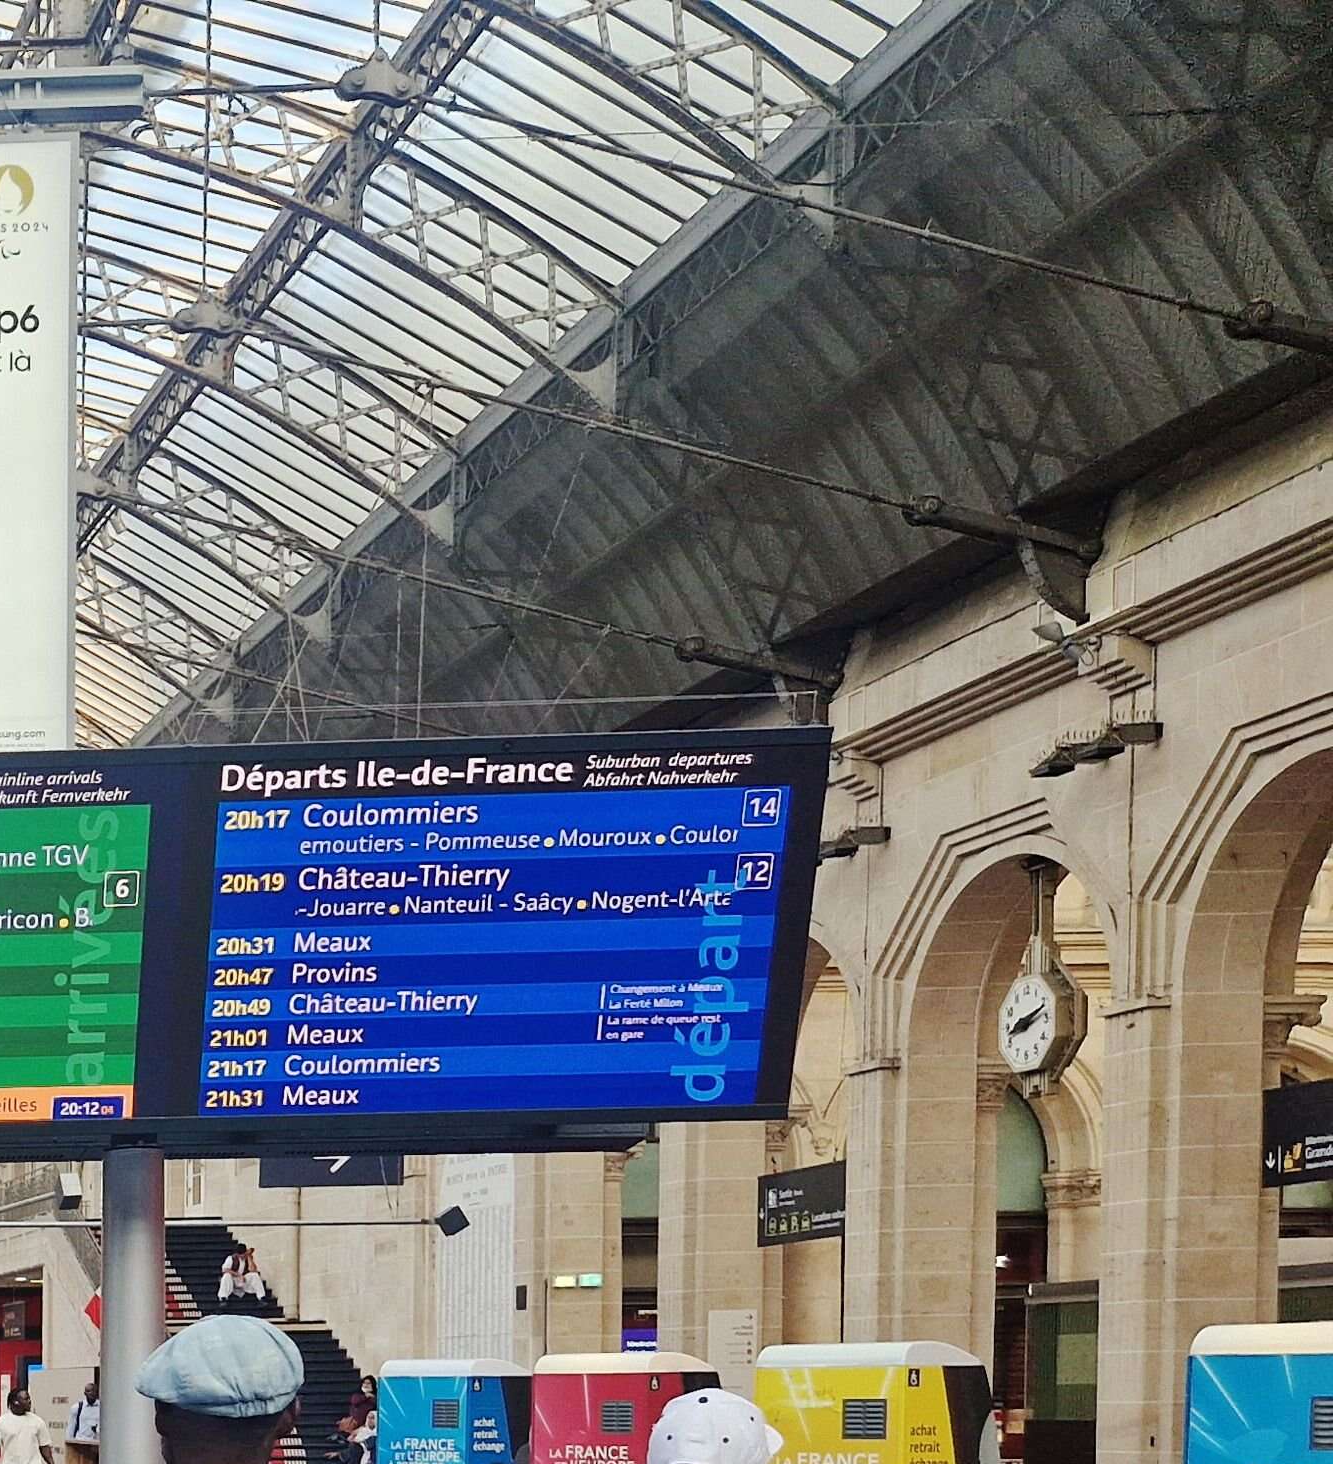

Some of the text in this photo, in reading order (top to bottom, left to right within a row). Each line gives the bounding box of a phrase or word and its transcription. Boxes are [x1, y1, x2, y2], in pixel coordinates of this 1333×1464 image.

[12, 222, 50, 233] 2024
[9, 348, 32, 373] là
[586, 752, 753, 769] Suburban departures
[47, 770, 103, 785] arrivals
[220, 757, 573, 797] Départs Ile-de-France
[583, 770, 739, 788] Abfahrt Nahverkehr
[41, 787, 131, 804] Fernverkehr
[224, 797, 777, 831] 20h17 Coulommiers 14
[300, 828, 651, 855] emoutiers Pommeuse Mouroux
[41, 844, 90, 867] TGV
[220, 861, 770, 894] 20h19 Château-Thierry 12
[115, 878, 129, 898] 6
[404, 892, 573, 915] Nanteuil Saâcy
[215, 932, 372, 956] 20h31 Meaux
[213, 962, 377, 987] 20h47 Provins
[610, 984, 676, 996] Changement
[211, 990, 478, 1018] 20h49 Château-Thierry
[210, 1024, 364, 1048] 21h01 Meaux
[207, 1052, 441, 1078] 21h17 Coulommiers
[205, 1085, 359, 1108] 21h31 Meaux
[60, 1101, 99, 1116] 20:12
[474, 1418, 495, 1427] achat
[910, 1424, 936, 1436] achat
[390, 1438, 455, 1450] LA FRANCE
[473, 1430, 498, 1439] retrait
[395, 1451, 460, 1462] ET L'EUROPE
[549, 1445, 629, 1460] LA FRANCE
[909, 1441, 940, 1453] retrait
